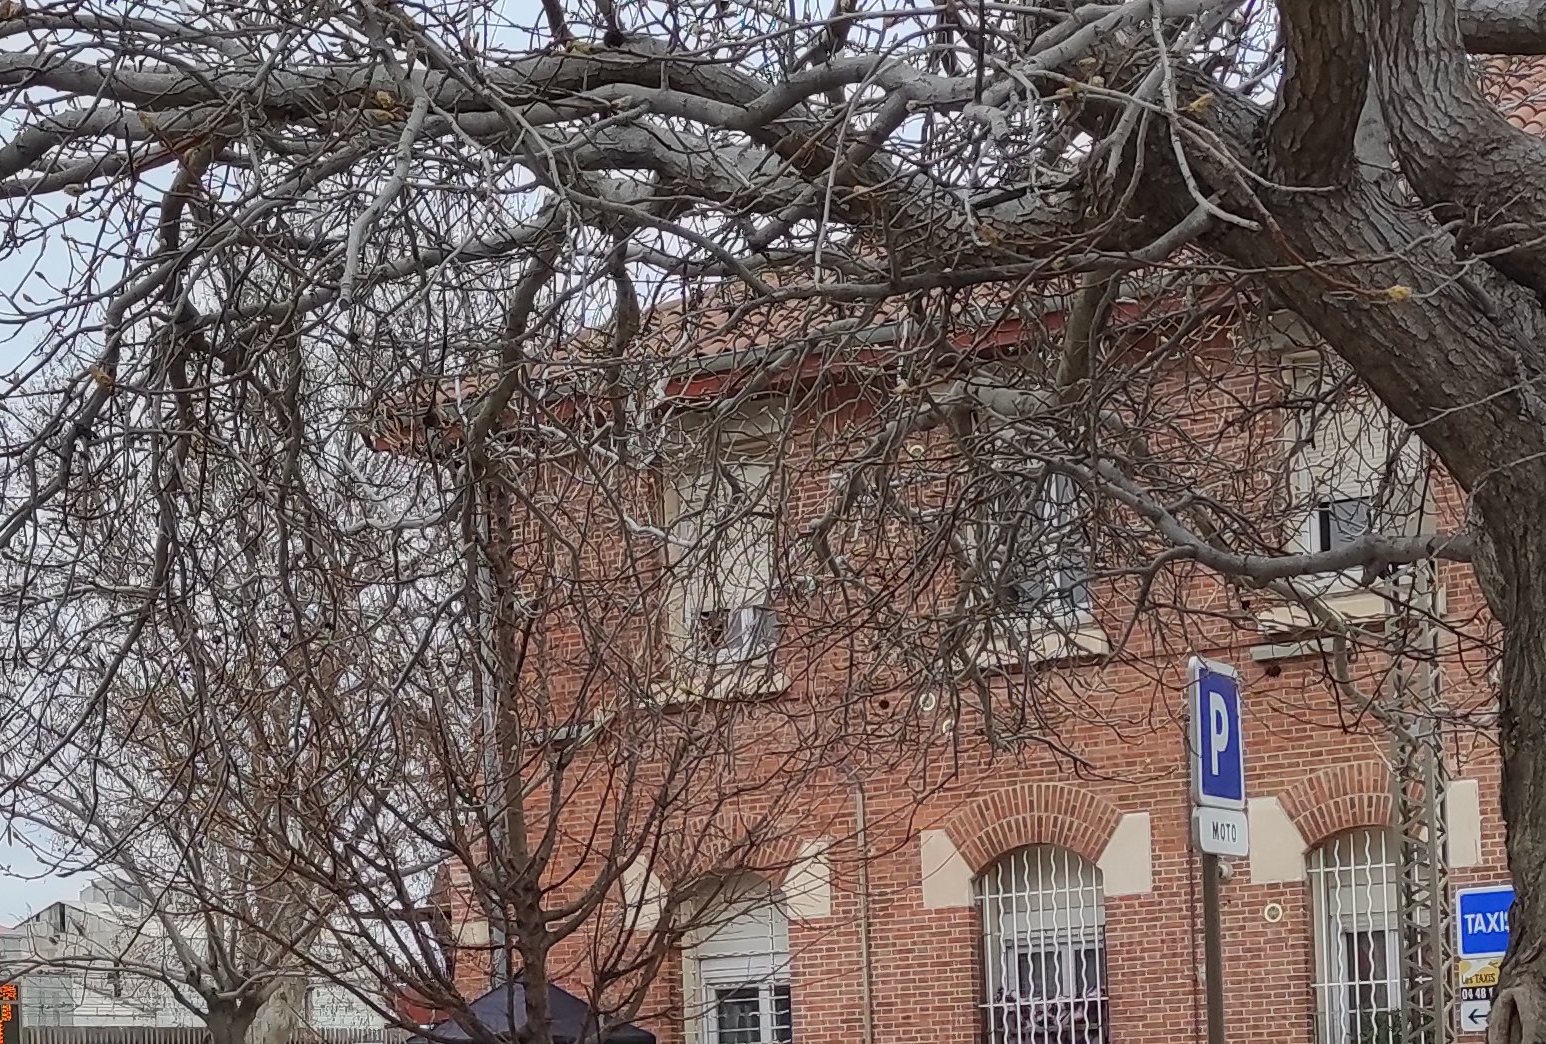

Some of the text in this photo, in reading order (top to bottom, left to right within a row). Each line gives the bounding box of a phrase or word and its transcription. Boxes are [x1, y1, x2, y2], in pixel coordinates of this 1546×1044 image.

[1209, 691, 1229, 776] P
[1212, 820, 1237, 843] MOTO
[1462, 988, 1473, 1000] 04
